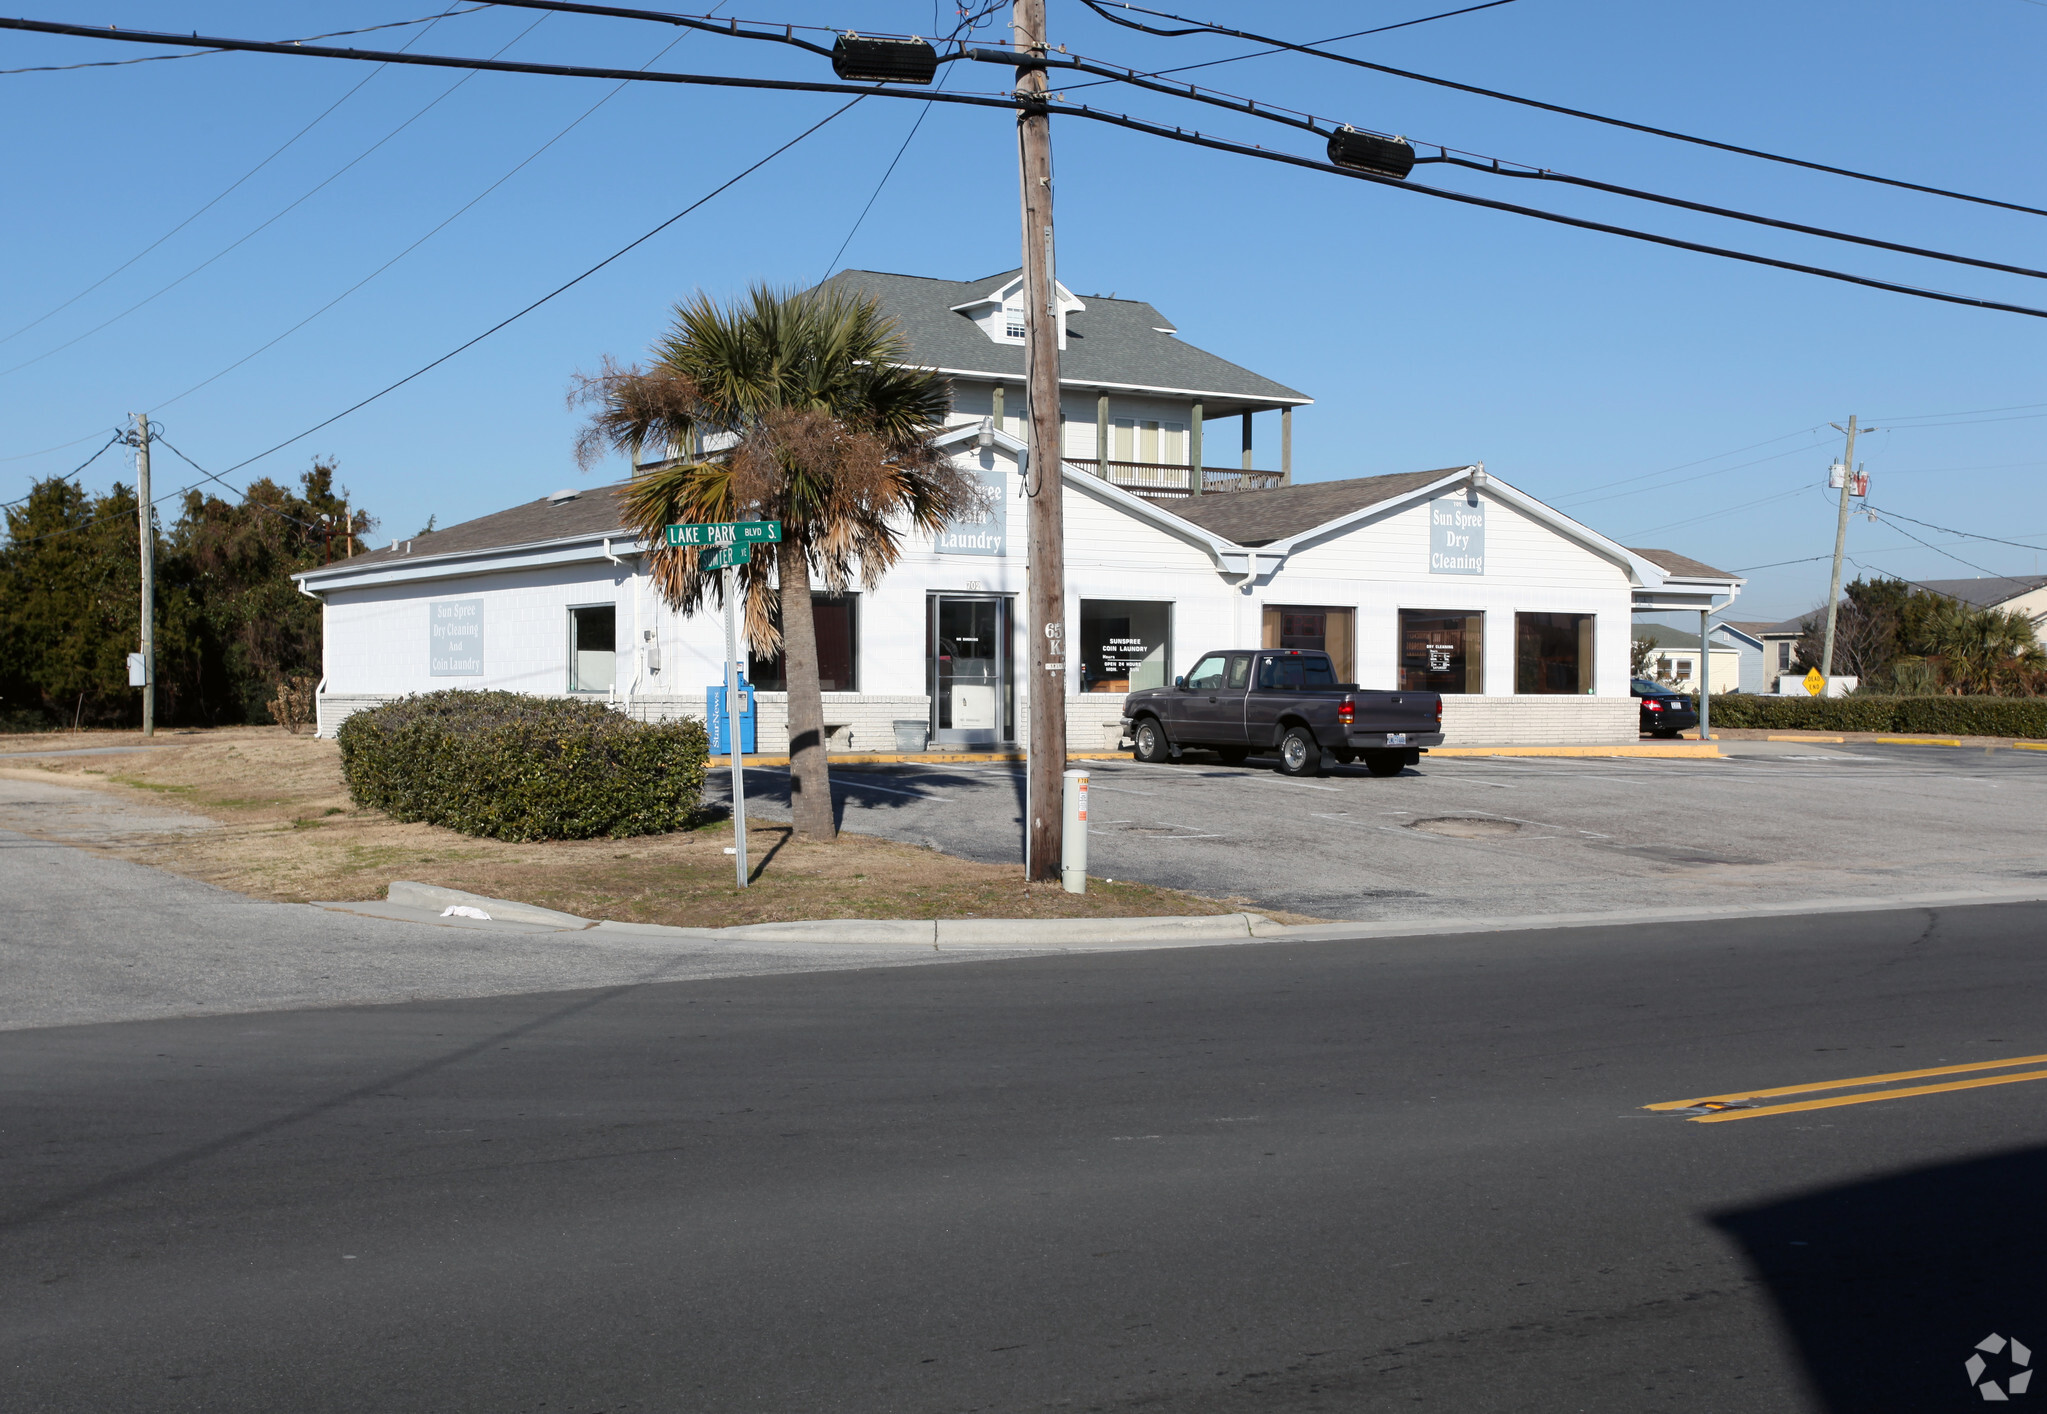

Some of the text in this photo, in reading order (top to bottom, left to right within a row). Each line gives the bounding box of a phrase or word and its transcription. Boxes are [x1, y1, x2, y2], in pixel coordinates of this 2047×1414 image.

[1433, 509, 1483, 530] Sun Spree
[670, 523, 777, 544] LAKE PARK BLVD S.
[941, 530, 1002, 554] Laundry
[1446, 530, 1469, 551] Dry
[703, 548, 734, 568] SUMTER
[1432, 552, 1483, 573] Cleaning
[966, 580, 981, 590] 702
[437, 603, 476, 620] Sun Spree
[433, 622, 479, 639] Dry Cleaning
[1045, 622, 1063, 639] 65
[448, 641, 463, 652] And
[432, 656, 480, 672] Coin Laundry
[712, 692, 720, 748] StarNews
